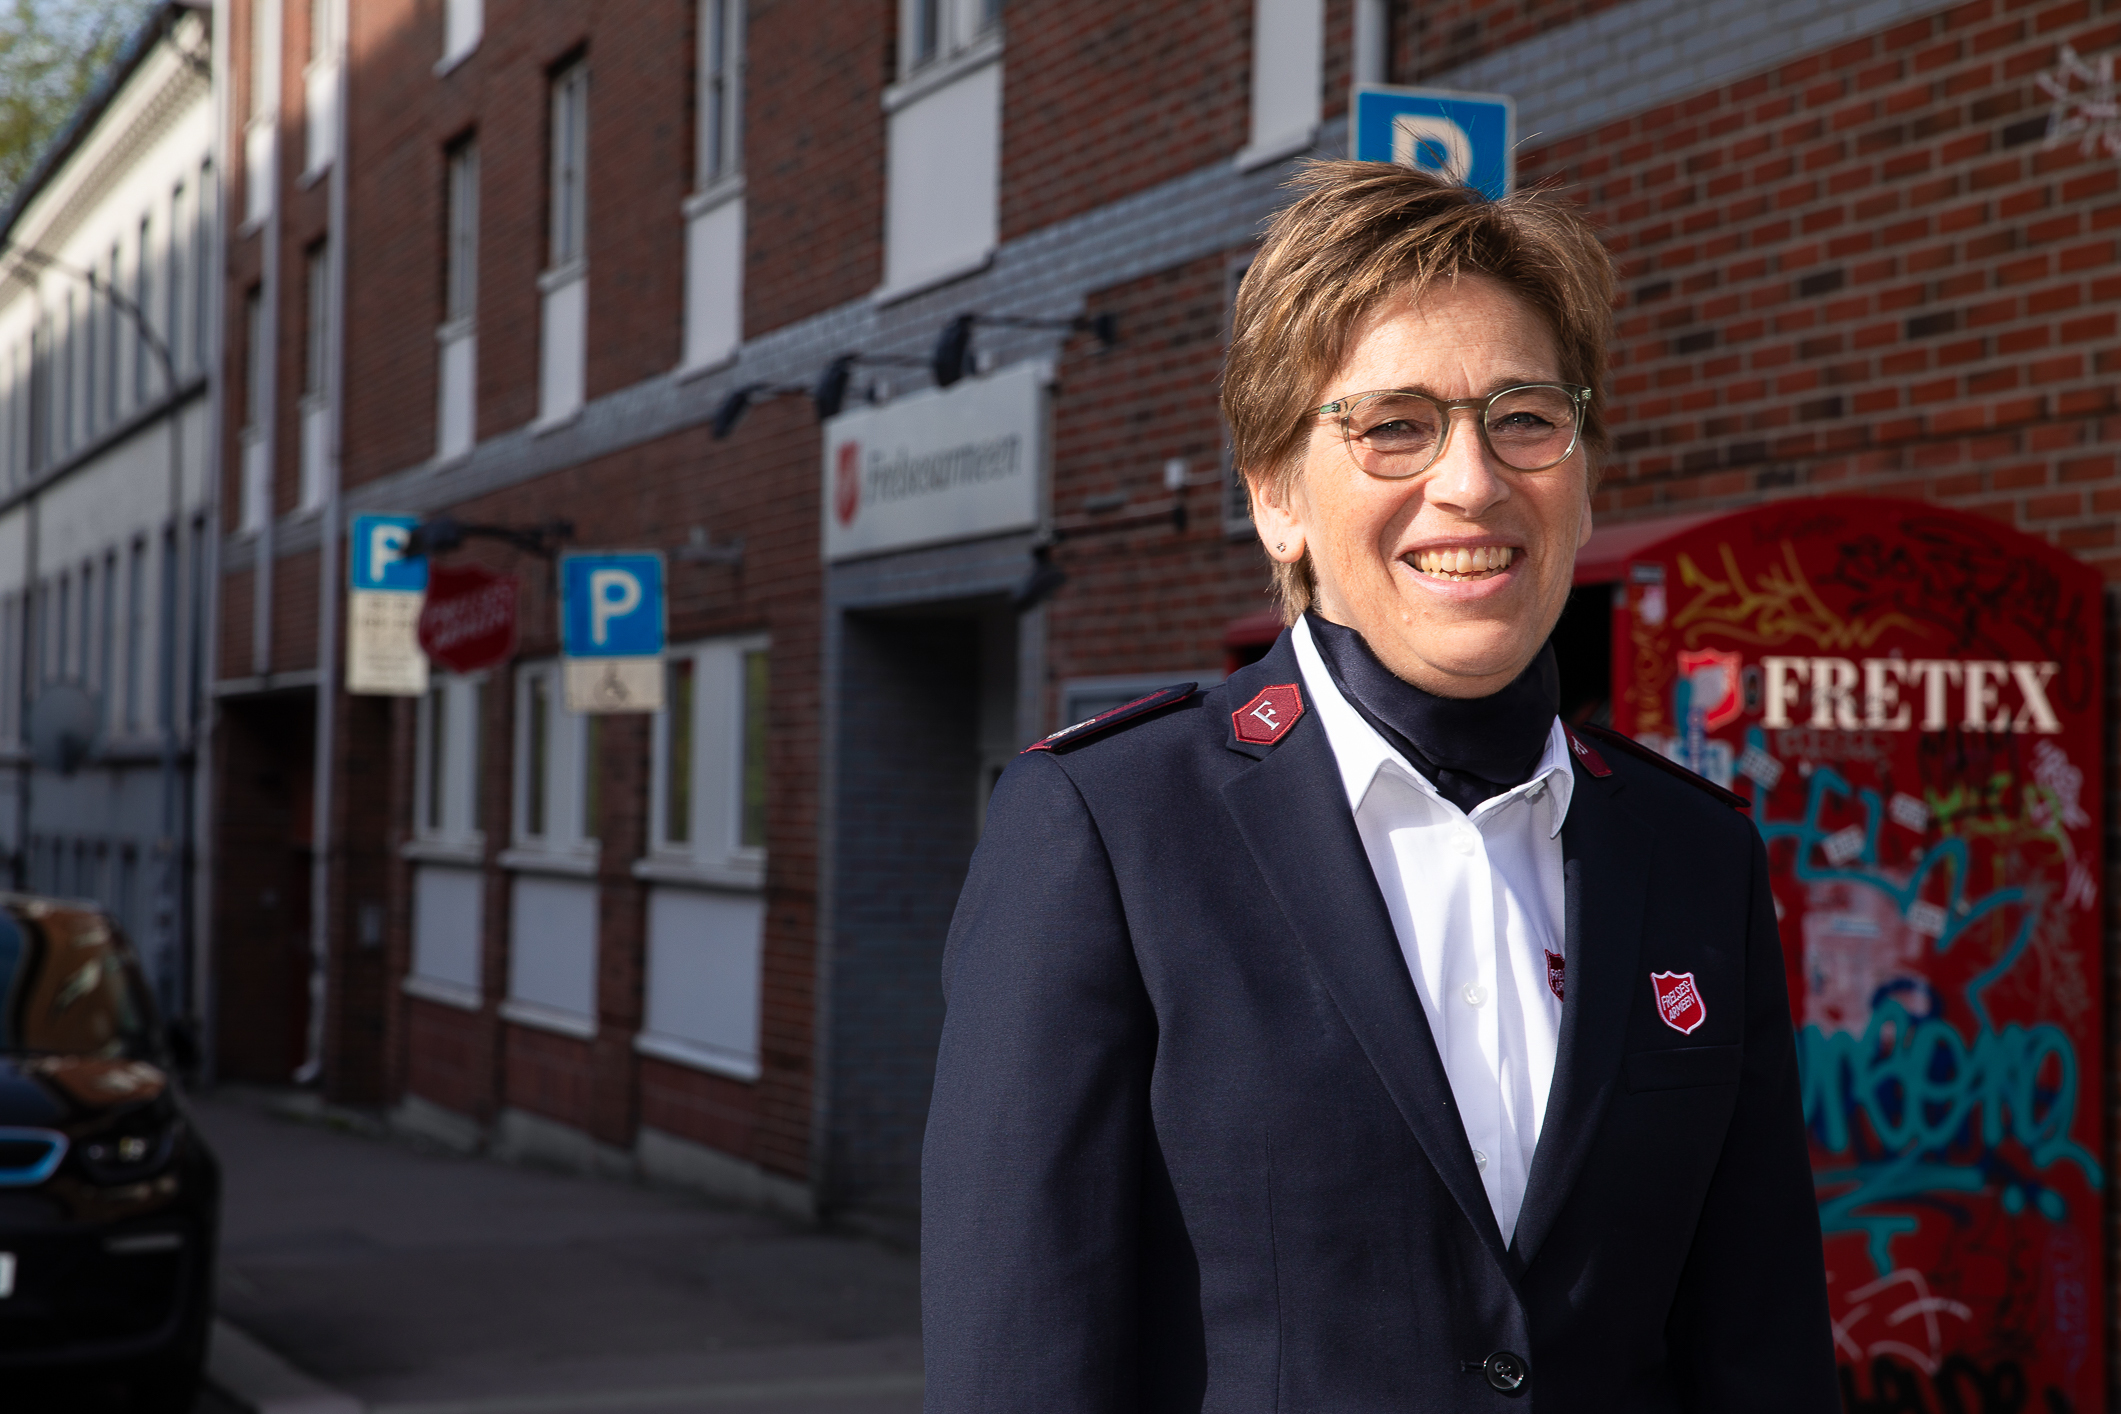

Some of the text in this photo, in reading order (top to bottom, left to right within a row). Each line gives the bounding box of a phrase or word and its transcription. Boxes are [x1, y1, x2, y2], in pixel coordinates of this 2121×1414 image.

[1391, 113, 1472, 188] P
[370, 523, 412, 583] P
[590, 568, 643, 646] P
[1250, 700, 1280, 730] F
[1760, 655, 2064, 734] FRETEX
[1669, 993, 1695, 1021] ARMEEN
